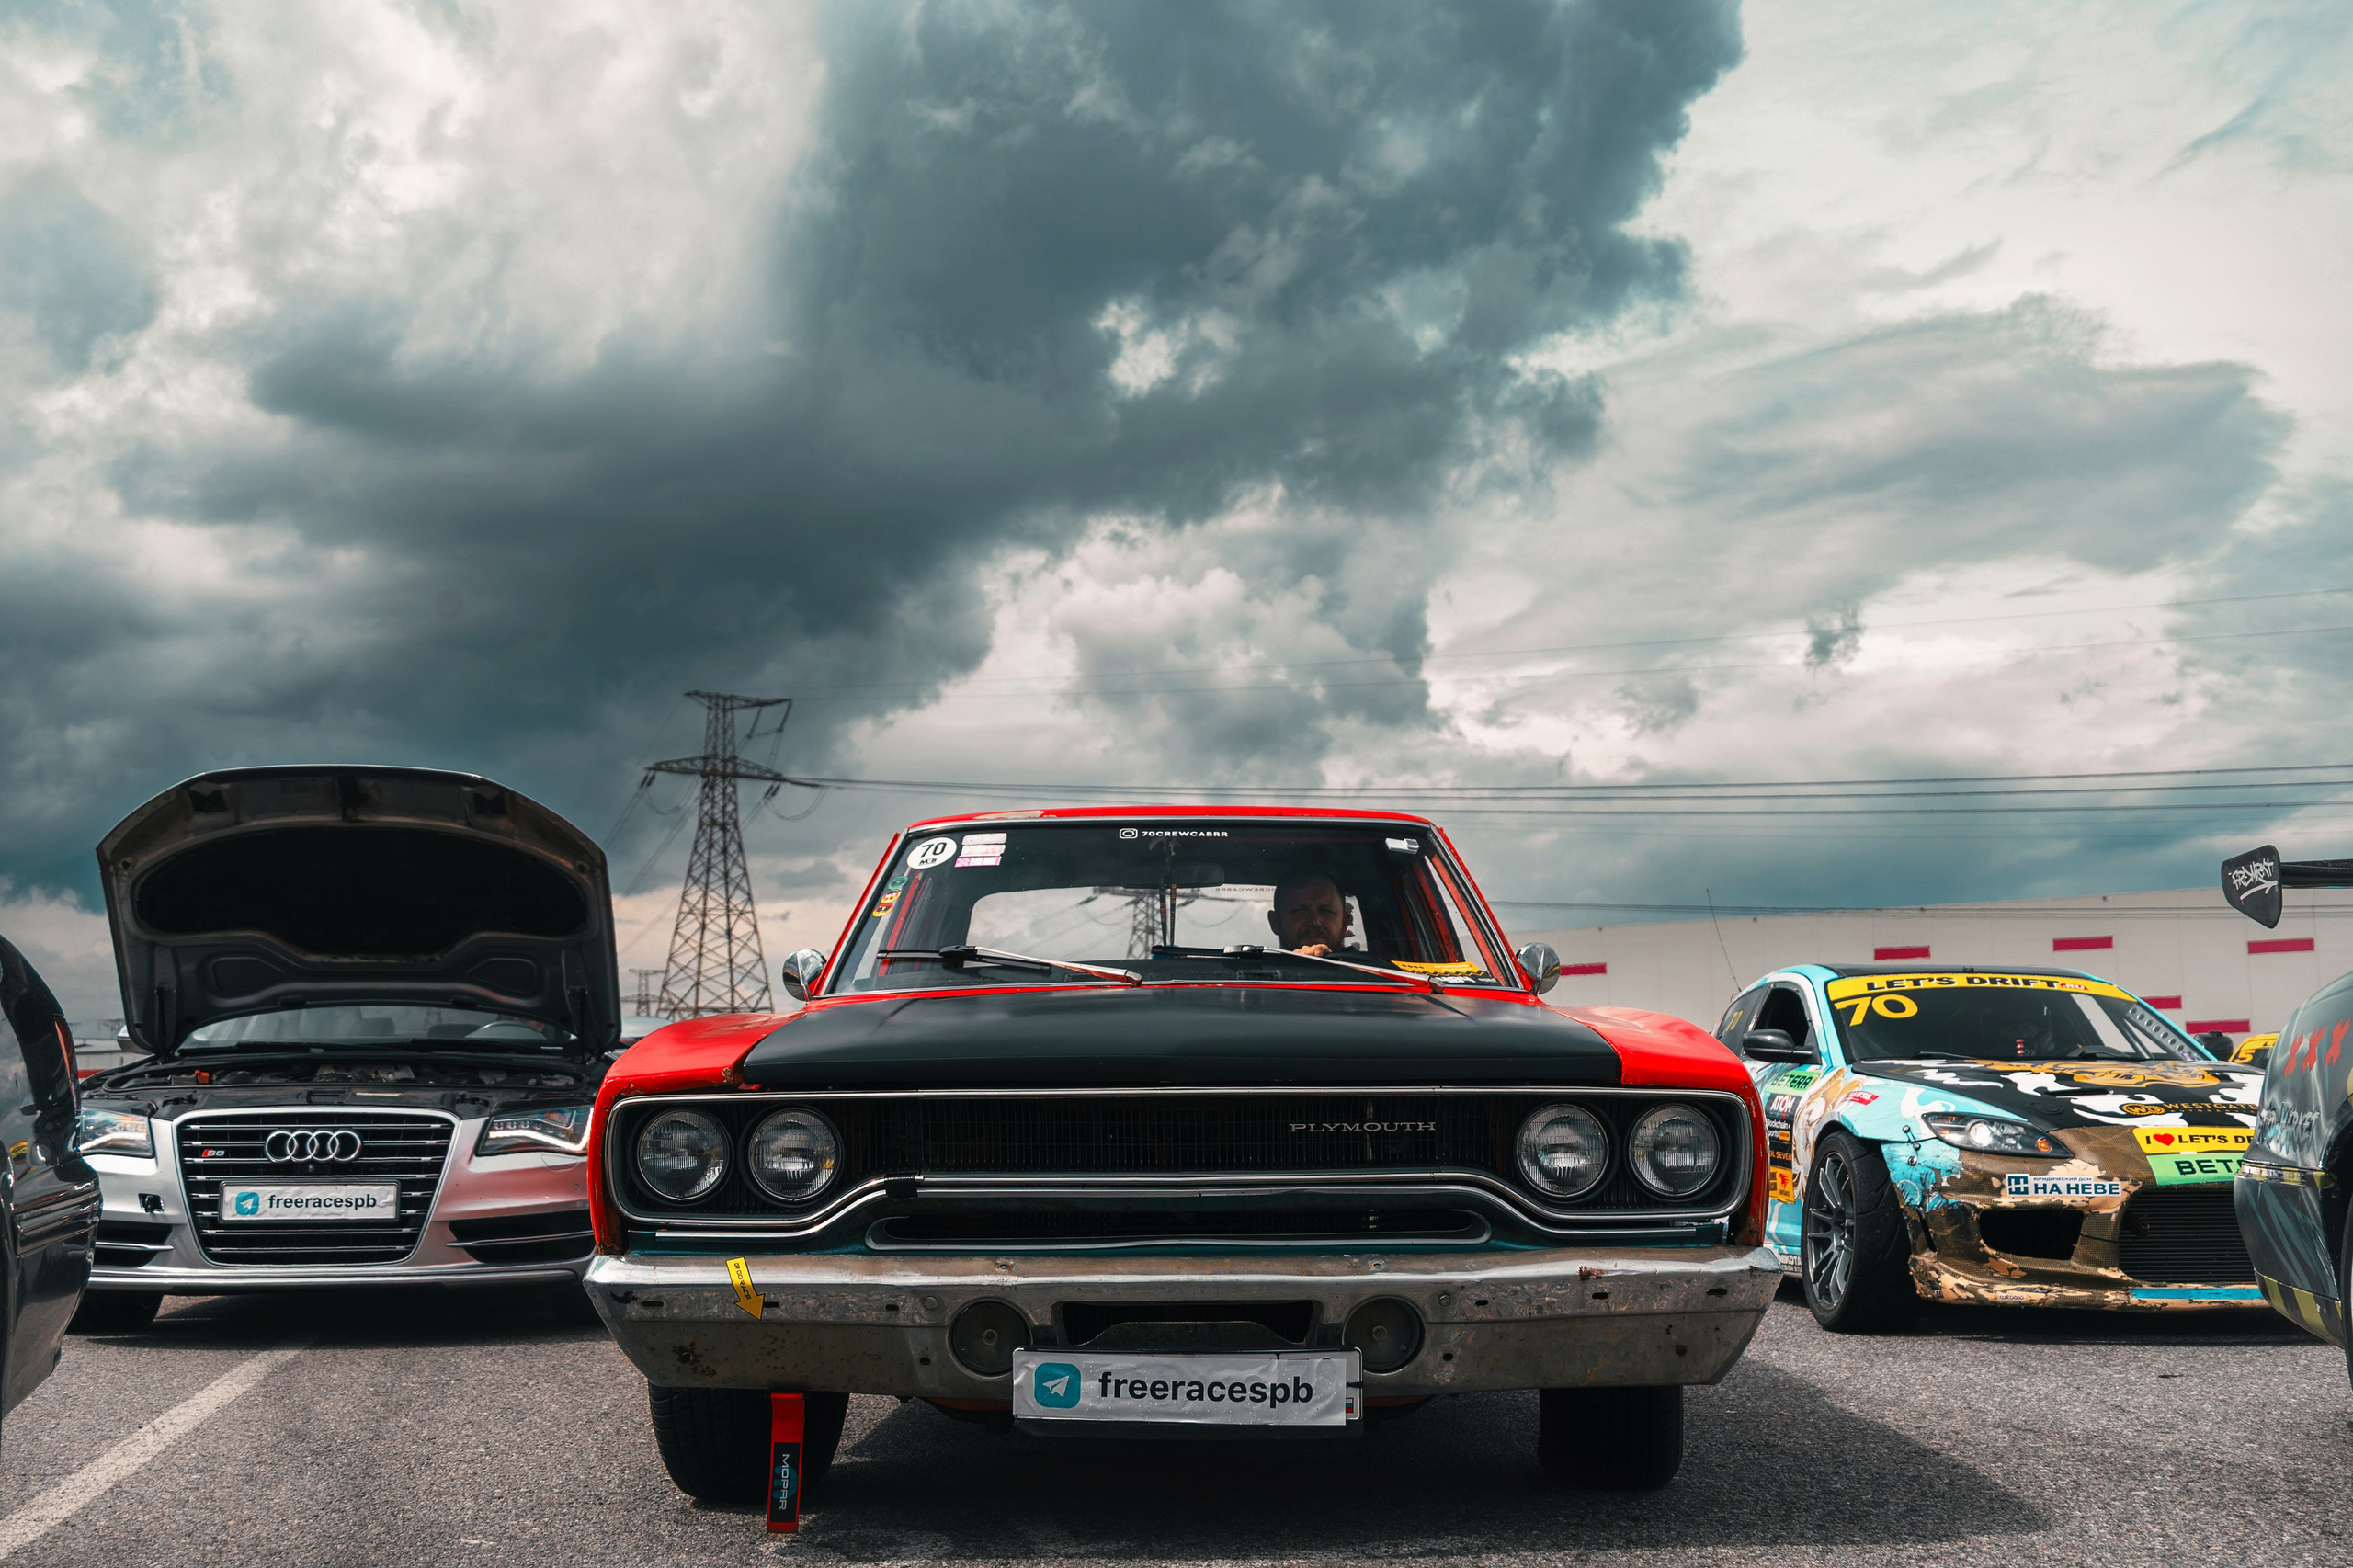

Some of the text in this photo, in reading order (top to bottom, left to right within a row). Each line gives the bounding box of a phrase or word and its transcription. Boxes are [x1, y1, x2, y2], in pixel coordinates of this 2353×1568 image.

[920, 842, 948, 858] 70
[1866, 977, 1958, 991] LET'S
[1834, 994, 1918, 1027] 70
[1726, 1010, 1743, 1031] 70
[1770, 1095, 1796, 1113] ATOM
[1290, 1121, 1437, 1132] PLYMOUTH
[2145, 1135, 2151, 1144] I
[2178, 1134, 2228, 1143] LET'S
[2174, 1159, 2243, 1176] BET
[2034, 1183, 2120, 1195] НА НЕВЕ
[268, 1194, 377, 1210] freeracespb
[1098, 1371, 1313, 1408] freeracespb
[779, 1453, 790, 1510] MOPAR
